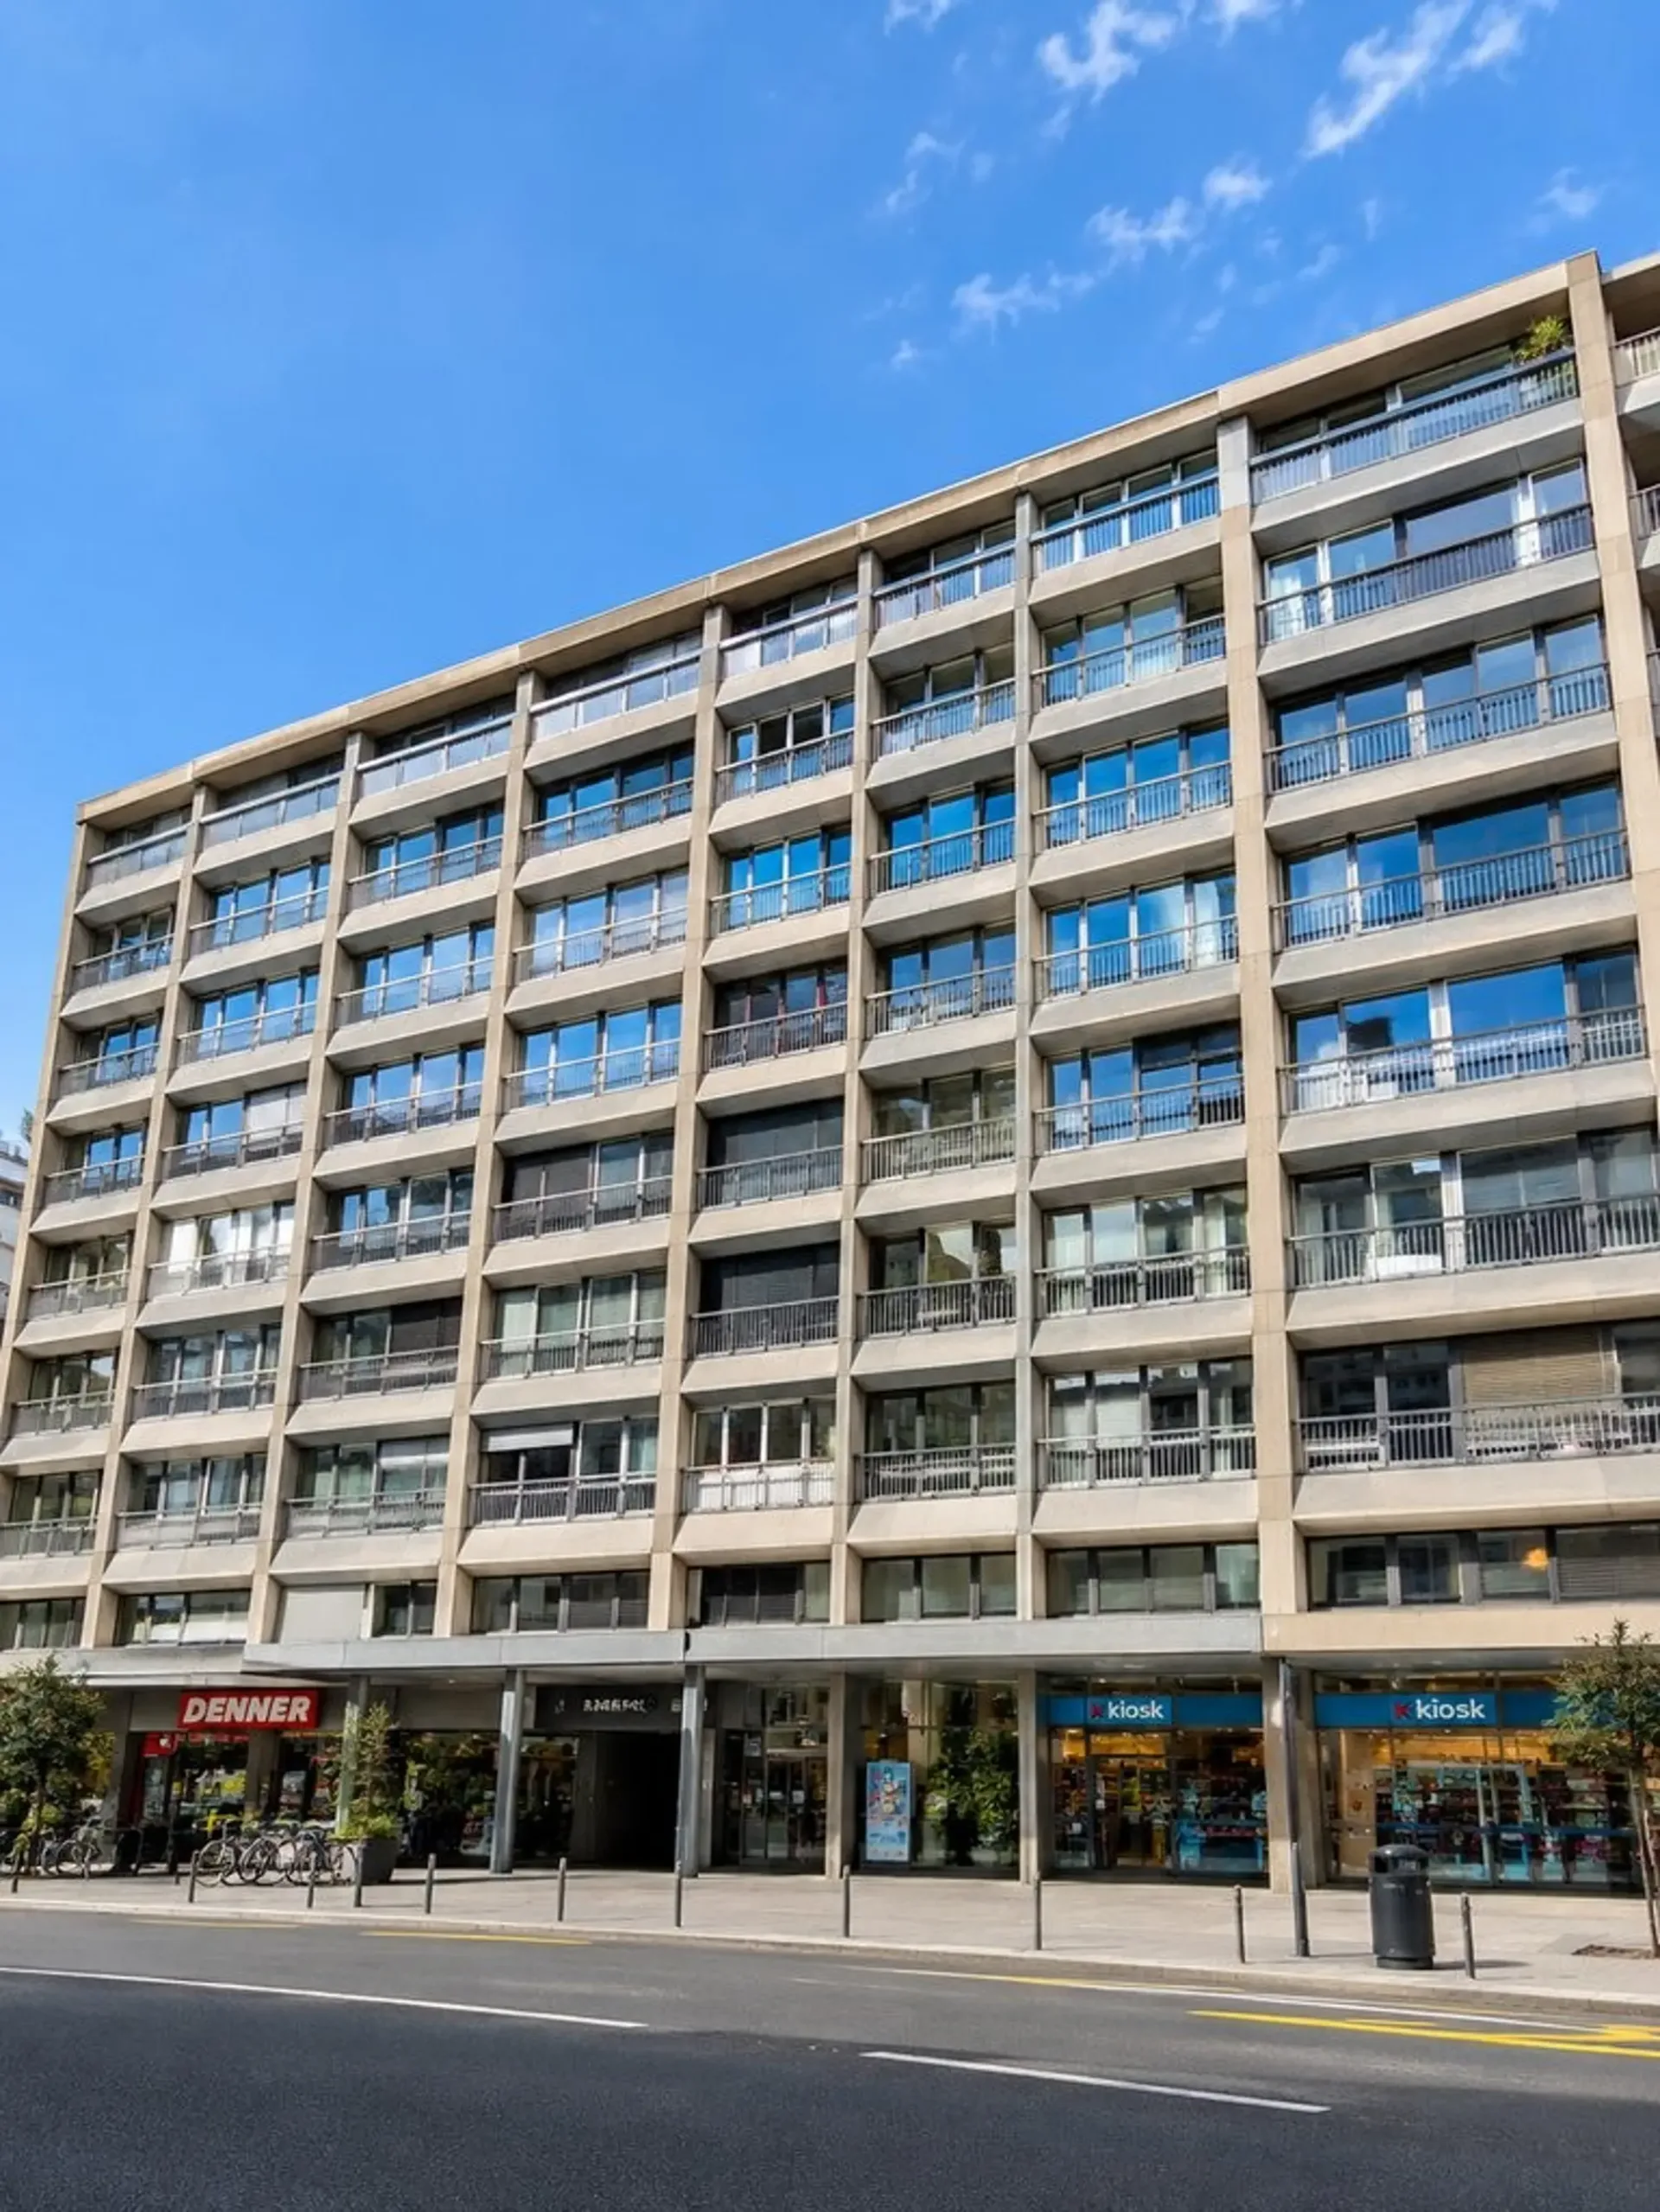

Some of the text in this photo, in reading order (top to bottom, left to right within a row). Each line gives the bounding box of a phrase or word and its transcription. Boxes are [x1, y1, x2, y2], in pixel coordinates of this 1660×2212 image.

[182, 1696, 311, 1723] DENNER
[1108, 1699, 1165, 1719] kiosk
[1416, 1698, 1485, 1719] kiosk
